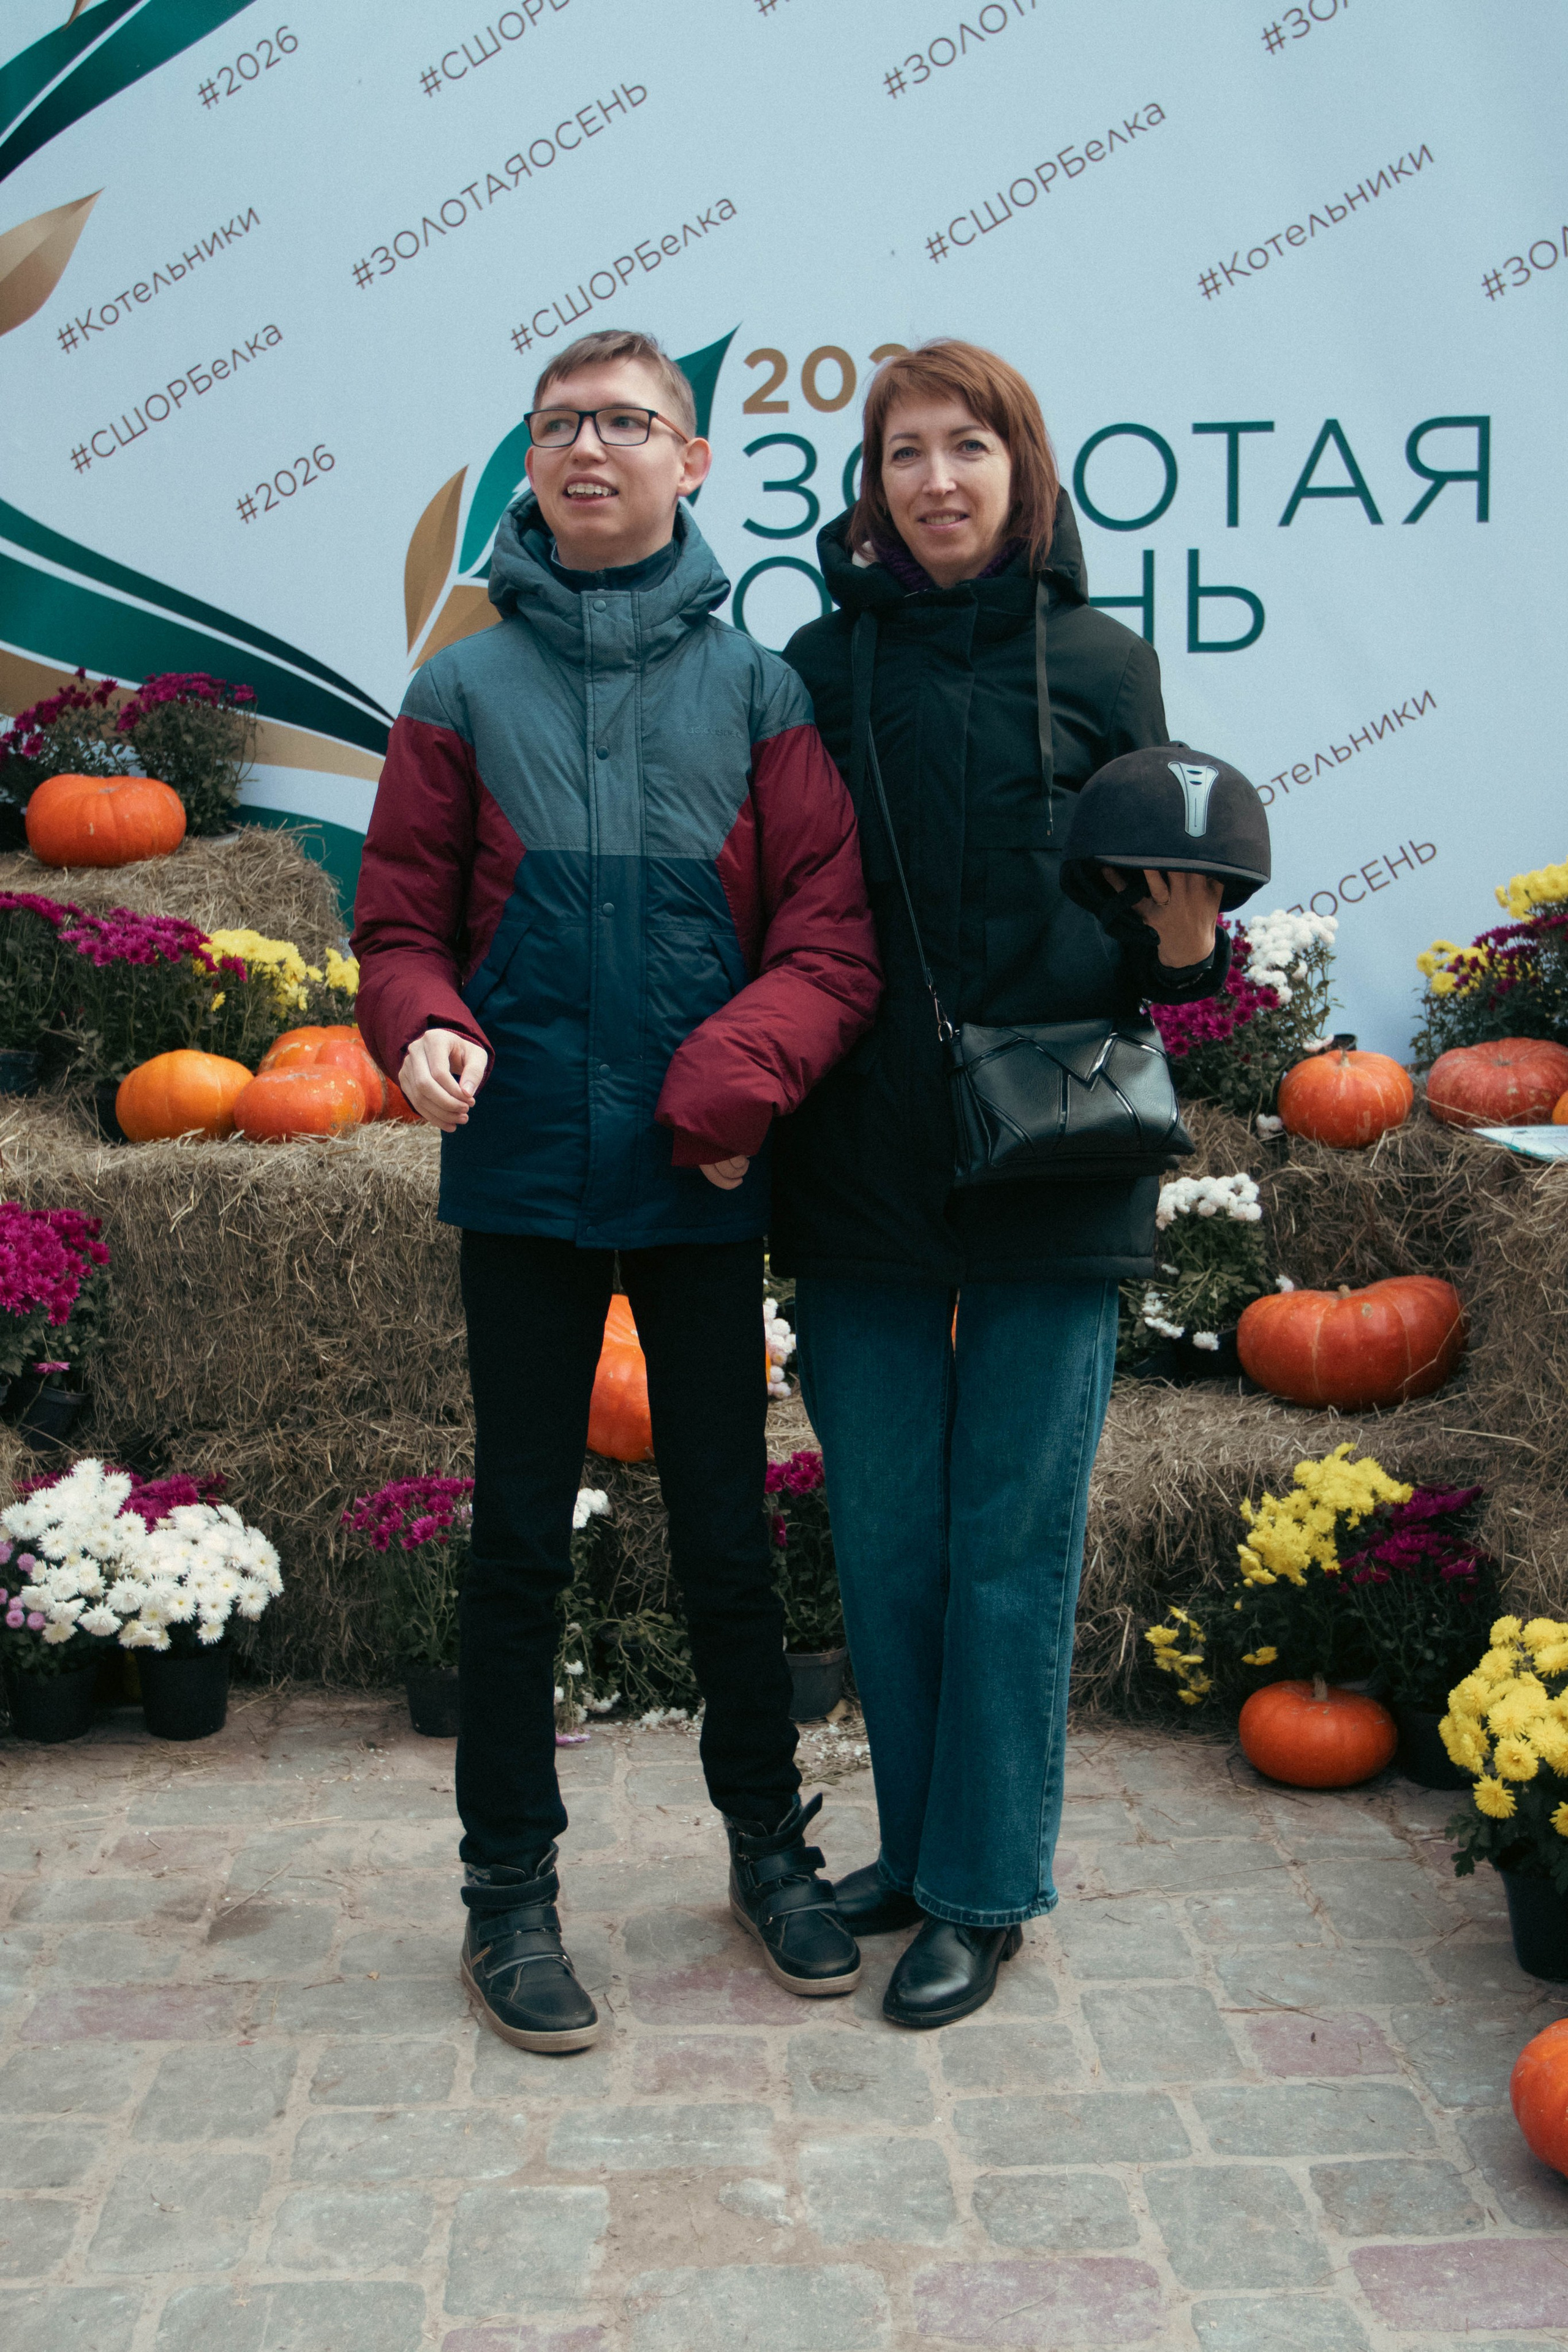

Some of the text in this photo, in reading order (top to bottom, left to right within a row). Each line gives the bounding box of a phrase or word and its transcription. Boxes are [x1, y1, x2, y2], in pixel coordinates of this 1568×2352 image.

[198, 25, 298, 110] #2026
[883, 0, 1036, 99] #ЗОЛО
[1261, 0, 1348, 55] #ЗО
[352, 83, 647, 290] #ЗОЛОТАЯОСЕНЬ
[925, 102, 1166, 263] #СШОРБелка
[1197, 144, 1434, 300] #Котельники
[57, 207, 261, 354] #Котельники
[510, 198, 737, 355] #СШОРБелка
[70, 323, 284, 474] #СШОРБелка
[742, 344, 908, 415] 20
[236, 444, 335, 524] #2026
[742, 416, 1490, 540] ЗОТАЯ
[733, 549, 1265, 654] ОНЬ
